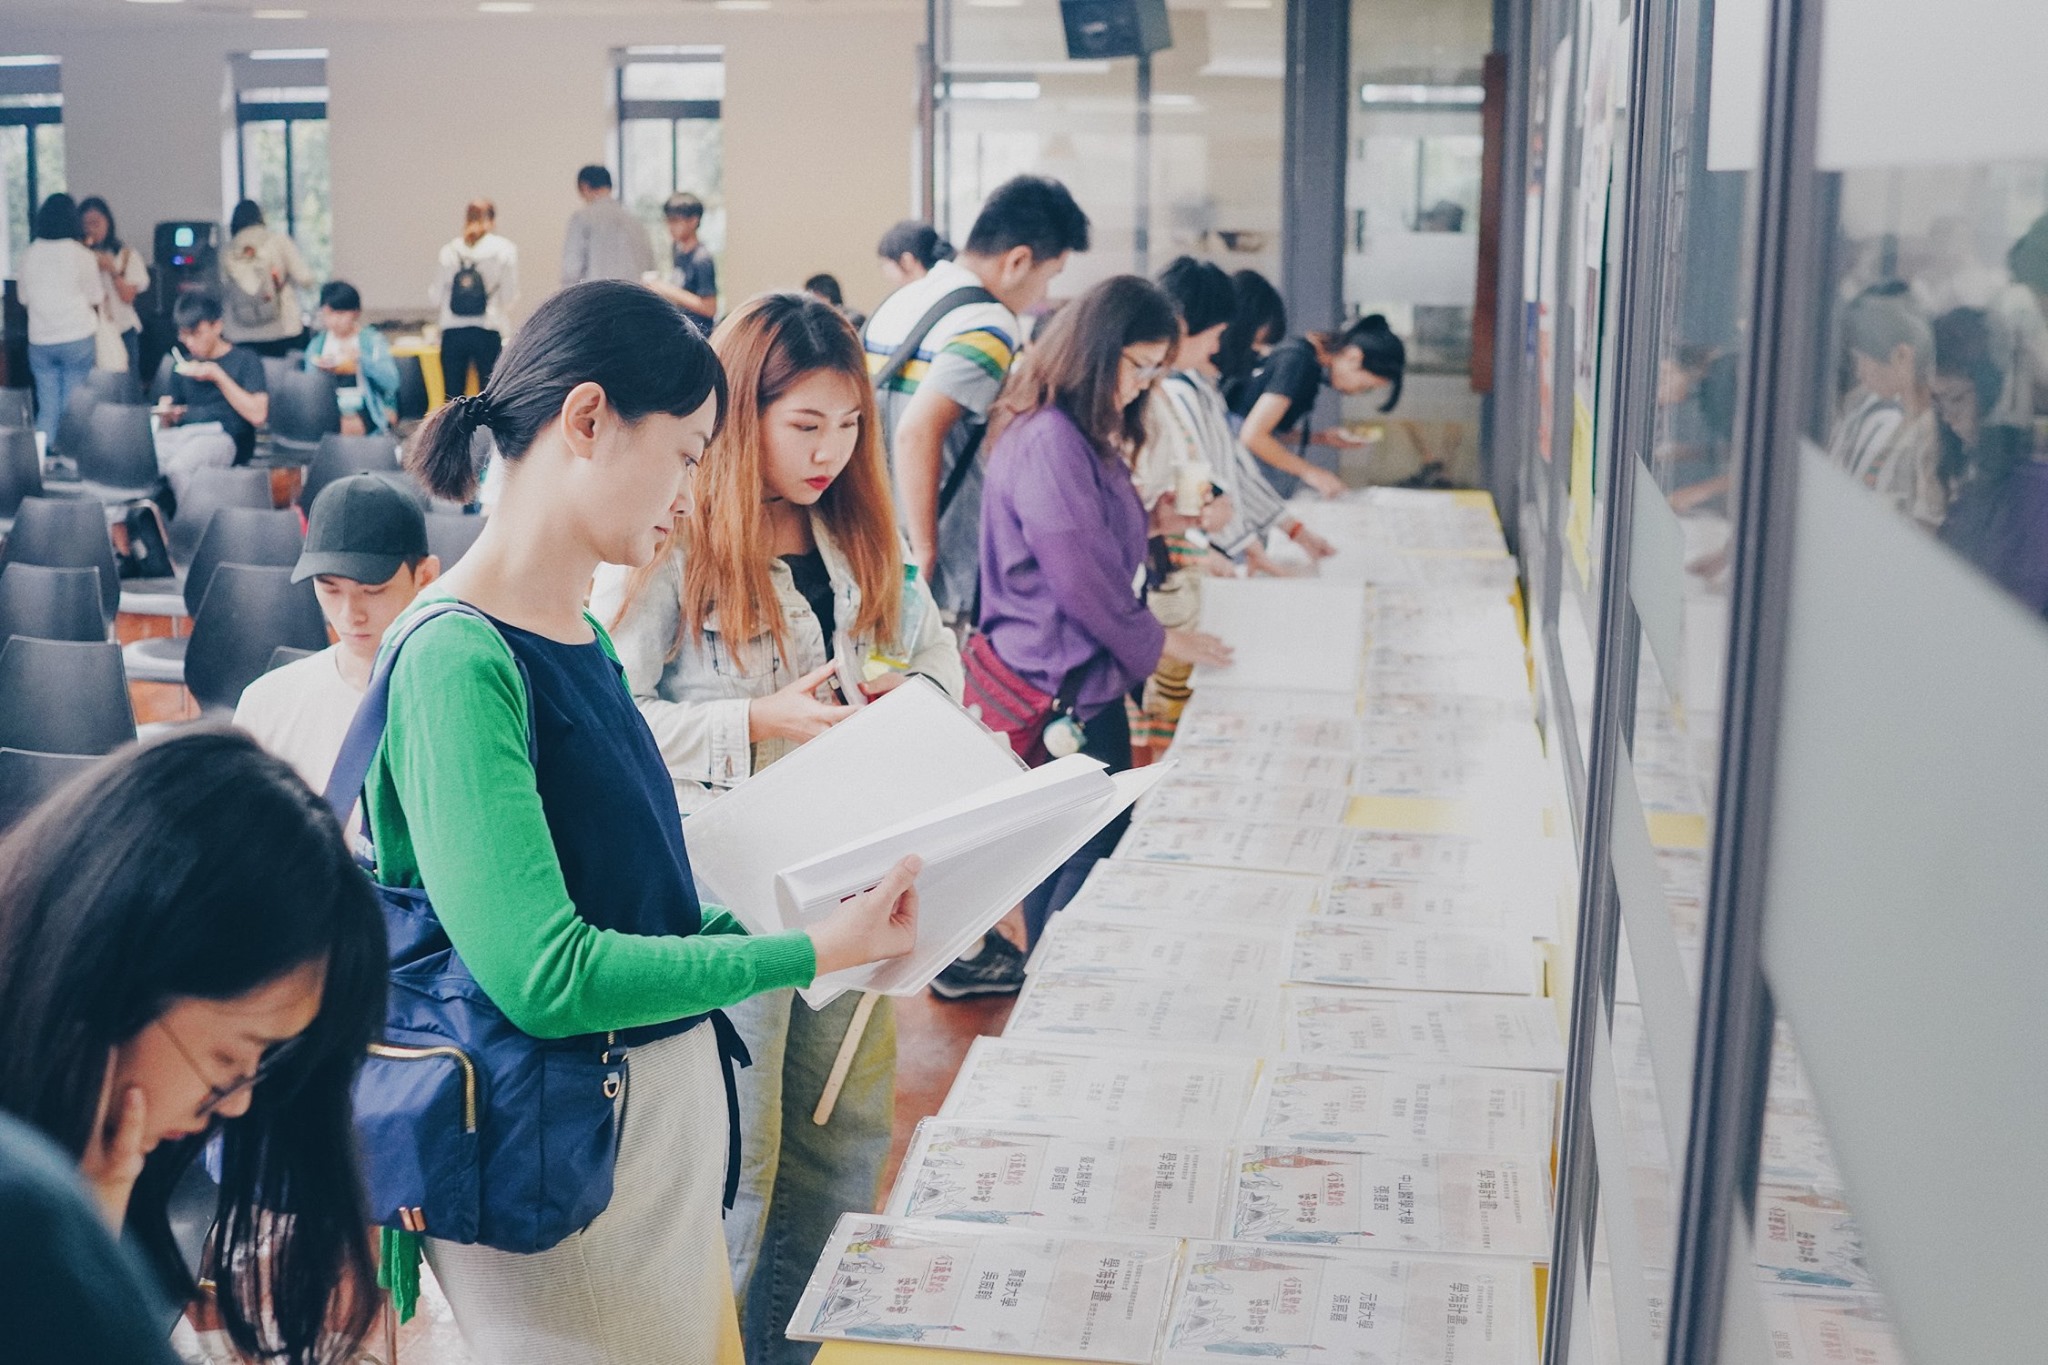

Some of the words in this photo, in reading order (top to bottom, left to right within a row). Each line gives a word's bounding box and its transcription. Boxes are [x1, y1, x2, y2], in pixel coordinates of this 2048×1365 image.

[1154, 1152, 1178, 1190] 學海計畫
[1476, 1169, 1498, 1211] 學海計畫
[1397, 1173, 1415, 1225] 中山醫學大學
[1000, 1268, 1027, 1308] 實踐大學
[1090, 1257, 1121, 1302] 學海計畫
[1355, 1291, 1378, 1329] 元智大學
[1446, 1282, 1470, 1326] 學海計畫
